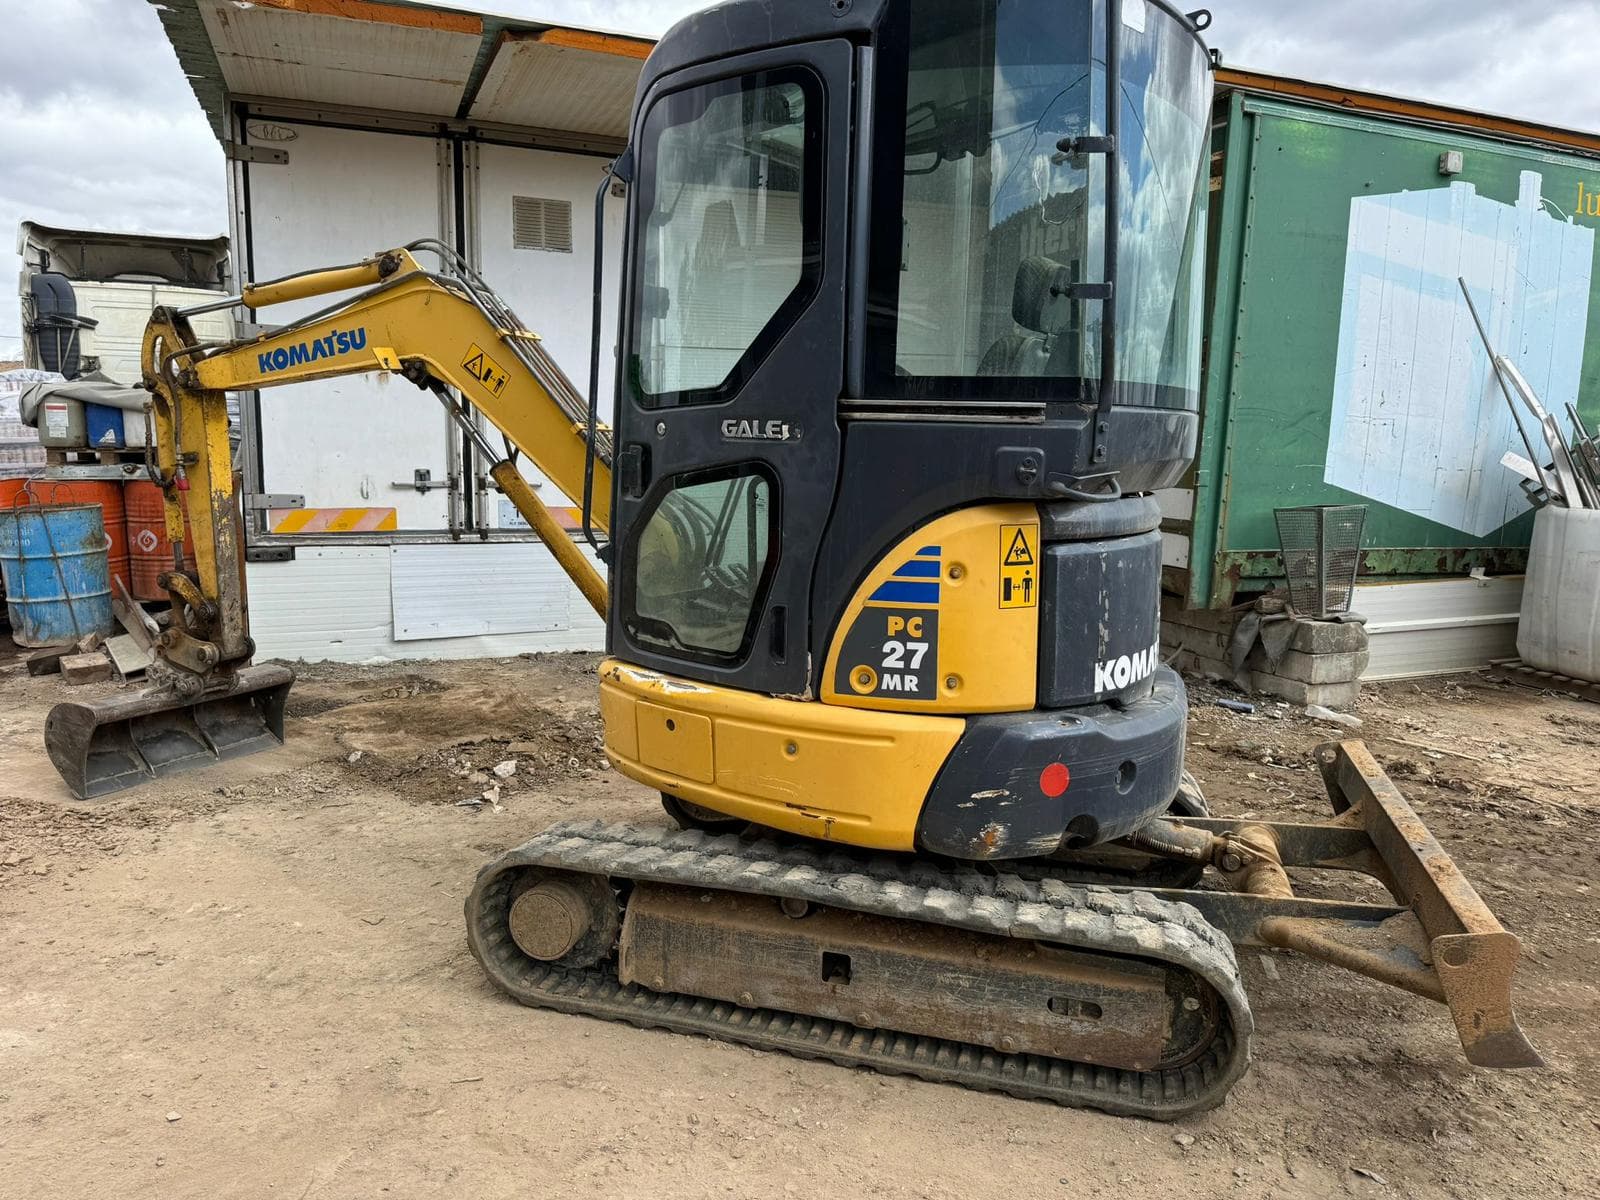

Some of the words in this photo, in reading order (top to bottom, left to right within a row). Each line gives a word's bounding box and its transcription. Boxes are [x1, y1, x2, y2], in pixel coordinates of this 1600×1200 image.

[257, 327, 367, 374] KOMATSU
[721, 419, 801, 441] GALE
[887, 615, 923, 638] PC
[881, 640, 929, 670] 27
[1094, 633, 1160, 693] KOMA
[881, 673, 920, 692] MR
